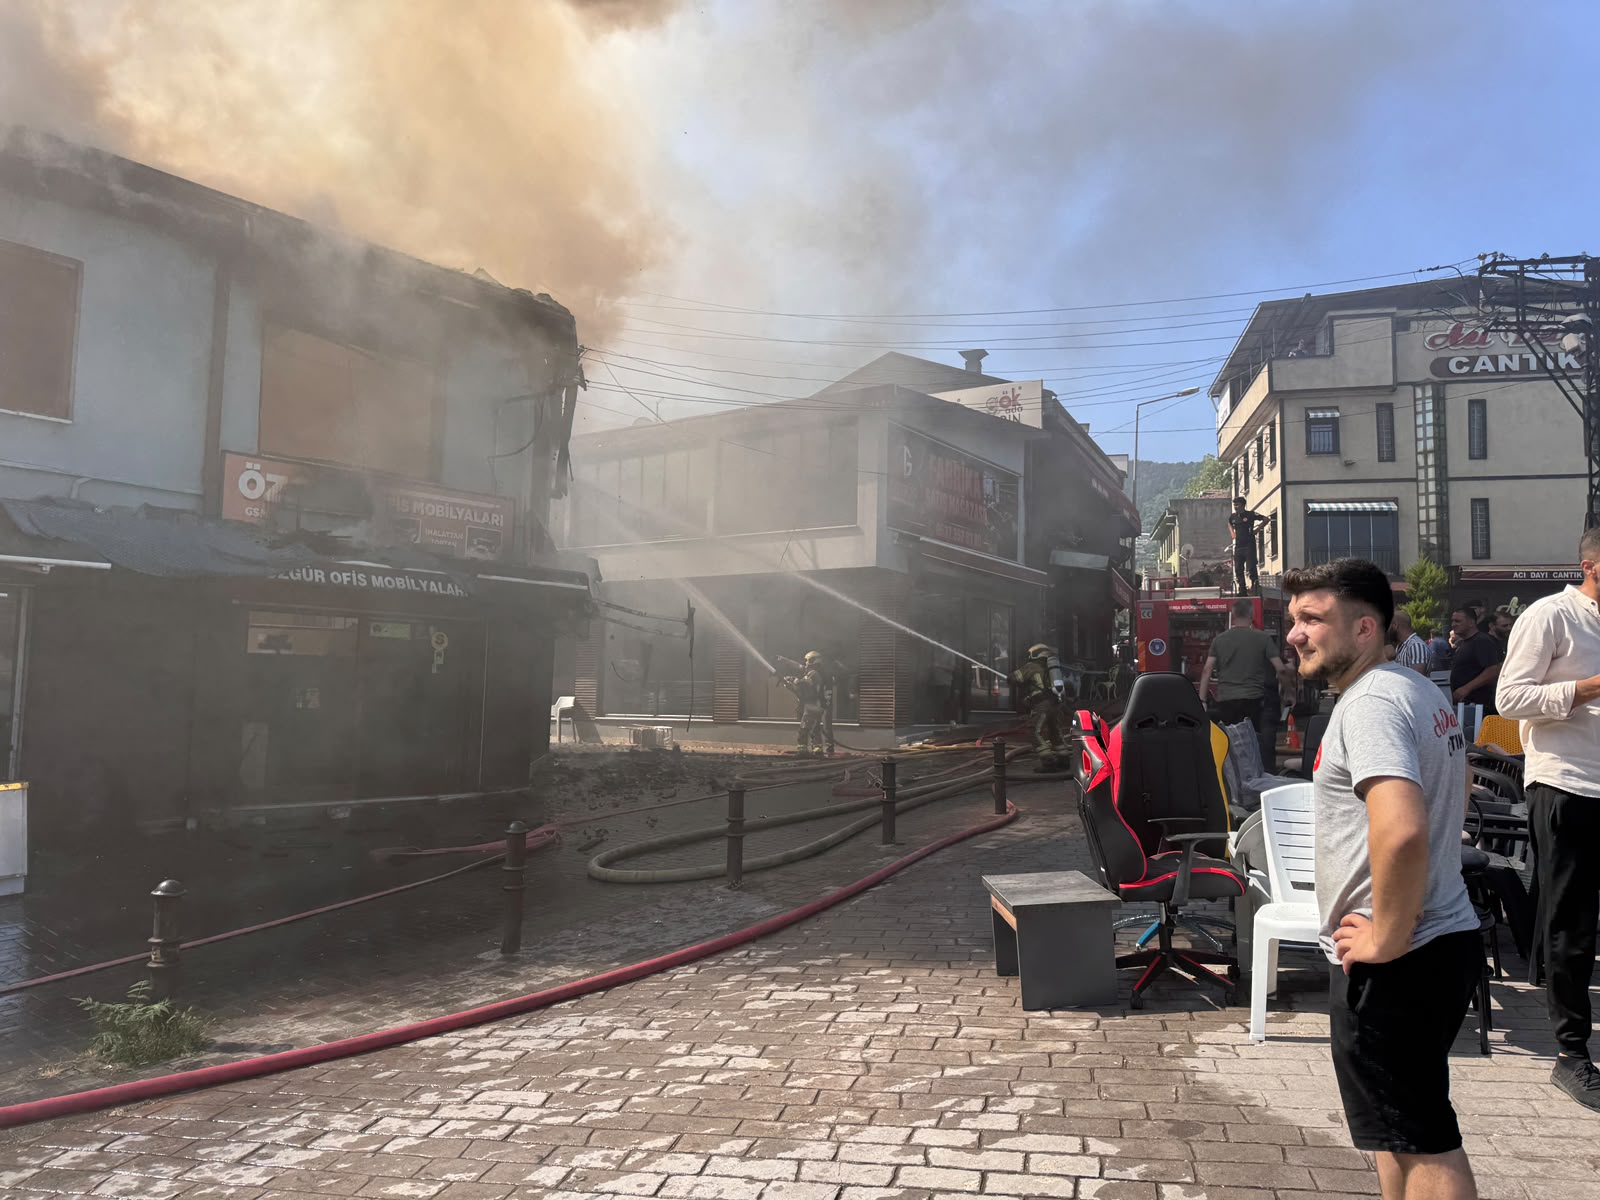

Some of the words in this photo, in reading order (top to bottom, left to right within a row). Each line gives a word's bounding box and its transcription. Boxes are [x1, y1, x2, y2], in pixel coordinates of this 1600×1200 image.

[1448, 352, 1582, 374] CANTIK
[413, 501, 504, 527] MOBİLYALARI
[330, 570, 368, 587] OFİS
[1513, 571, 1526, 579] ACI
[1530, 571, 1548, 579] DAYI
[1552, 571, 1583, 579] CANTIK
